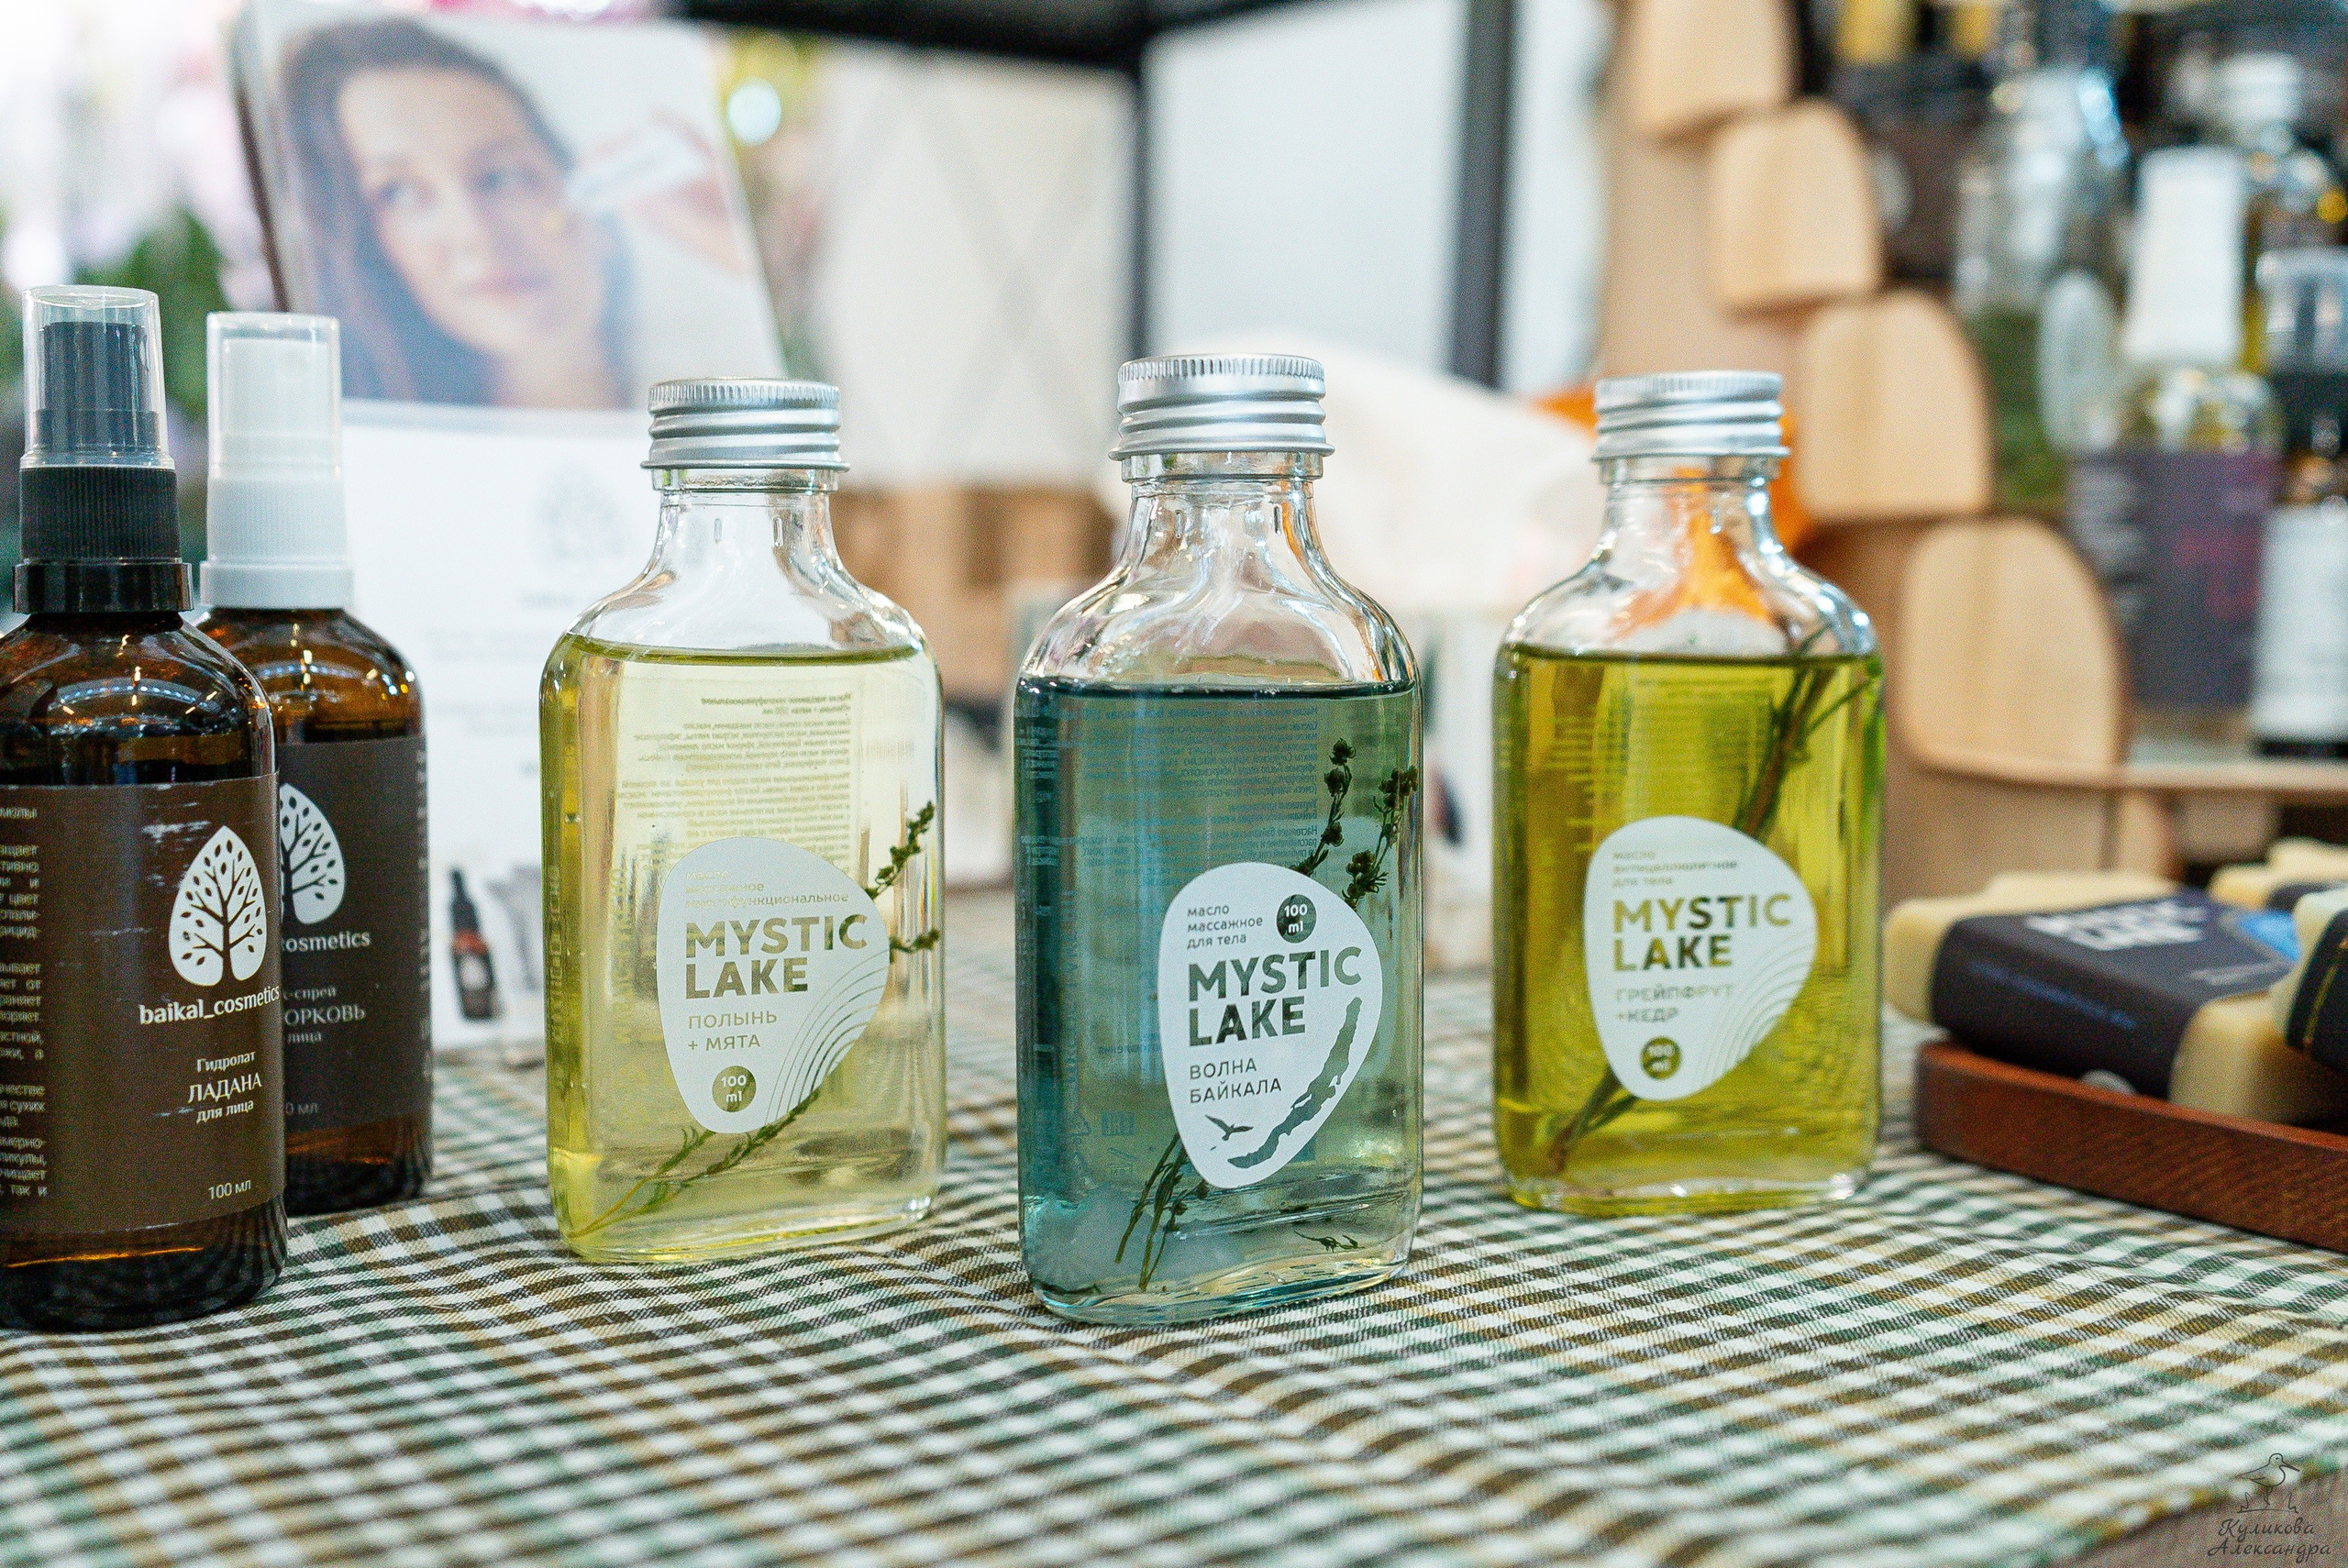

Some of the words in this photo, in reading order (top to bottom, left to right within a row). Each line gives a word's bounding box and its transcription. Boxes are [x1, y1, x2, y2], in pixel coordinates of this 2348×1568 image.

[1186, 903, 1230, 917] масло
[1283, 903, 1308, 918] 100
[1611, 892, 1791, 934] MYSTIC
[1186, 916, 1264, 933] массажное
[1287, 920, 1304, 934] ml
[282, 931, 371, 953] osmetics
[685, 913, 868, 959] MYSTIC
[1186, 936, 1215, 950] для
[1217, 932, 1247, 946] тела
[1611, 933, 1733, 972] LAKE
[685, 956, 809, 1000] LAKE
[1188, 945, 1363, 1002] MYSTIC
[1615, 983, 1734, 1003] ГРЕЙПФРУТ
[139, 985, 280, 1025] baikal_cosmetics
[284, 1003, 366, 1027] ОРКОВЬ
[688, 1010, 778, 1031] ПОЛЫНЬ
[1188, 995, 1307, 1048] LAKE
[705, 1033, 761, 1052] МЯТА
[196, 1051, 256, 1073] Гидролат
[1189, 1057, 1257, 1080] ВОЛНА
[187, 1072, 262, 1104] ЛАДАНА
[720, 1073, 748, 1088] 100
[1189, 1076, 1282, 1105] БАЙКАЛА
[725, 1089, 744, 1103] ml
[196, 1105, 223, 1125] для
[226, 1099, 255, 1116] лица
[208, 1181, 233, 1200] 100
[235, 1179, 252, 1194] мл
